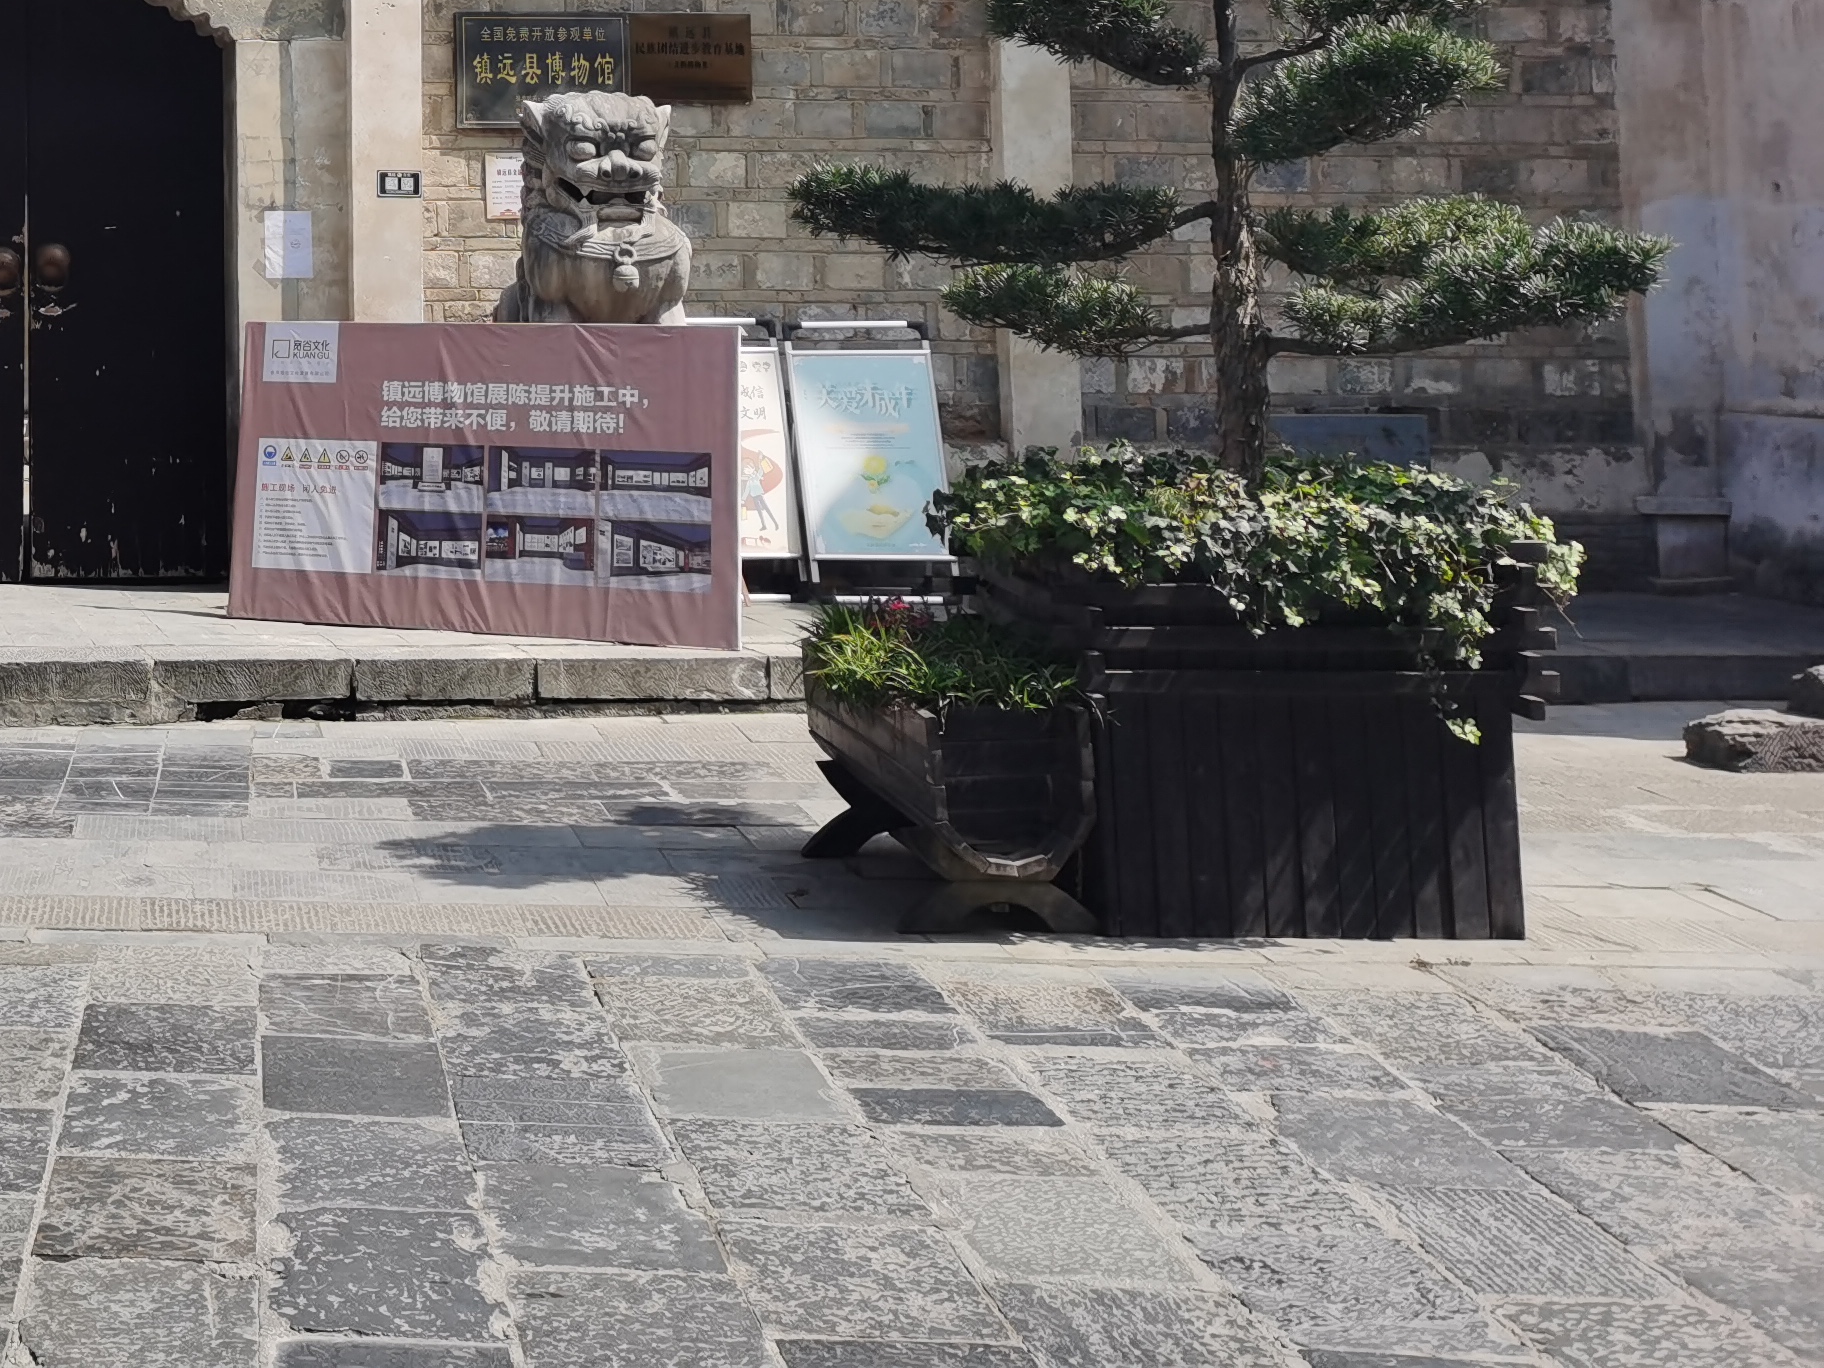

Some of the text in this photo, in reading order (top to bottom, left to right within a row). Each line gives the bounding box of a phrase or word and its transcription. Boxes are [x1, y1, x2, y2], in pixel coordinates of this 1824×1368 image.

[480, 26, 607, 42] 全国免费开放参观单位
[472, 51, 615, 85] 镇远县博物馆
[293, 339, 330, 352] 宽谷文化
[292, 351, 316, 360] KUAN
